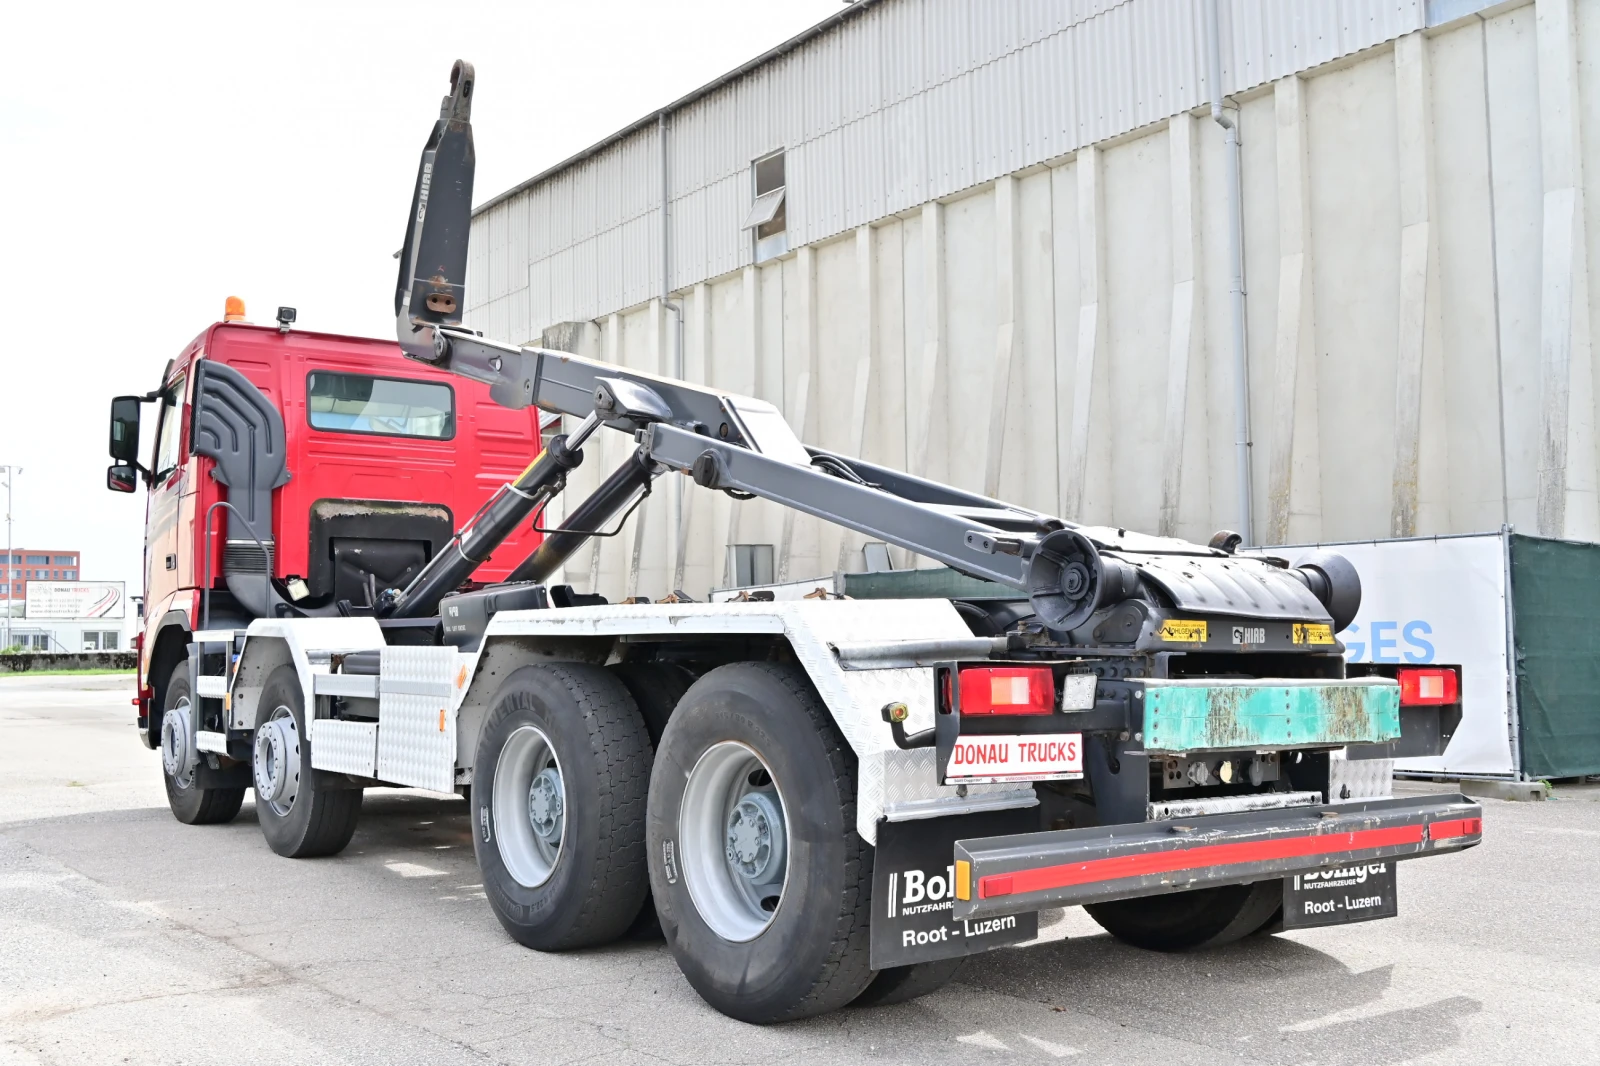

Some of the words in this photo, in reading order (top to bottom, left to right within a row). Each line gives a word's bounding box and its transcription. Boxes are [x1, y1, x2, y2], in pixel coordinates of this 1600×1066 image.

[420, 163, 432, 200] HIAB
[1244, 627, 1266, 644] HIAB
[954, 744, 1009, 765] DONAU
[1018, 742, 1077, 763] TRUCKS
[1304, 879, 1356, 890] NUTZFAHRZEUGE
[1304, 900, 1335, 914] Root
[1345, 895, 1382, 910] Luzern
[903, 926, 948, 947] Root
[964, 915, 1016, 938] Luzern
